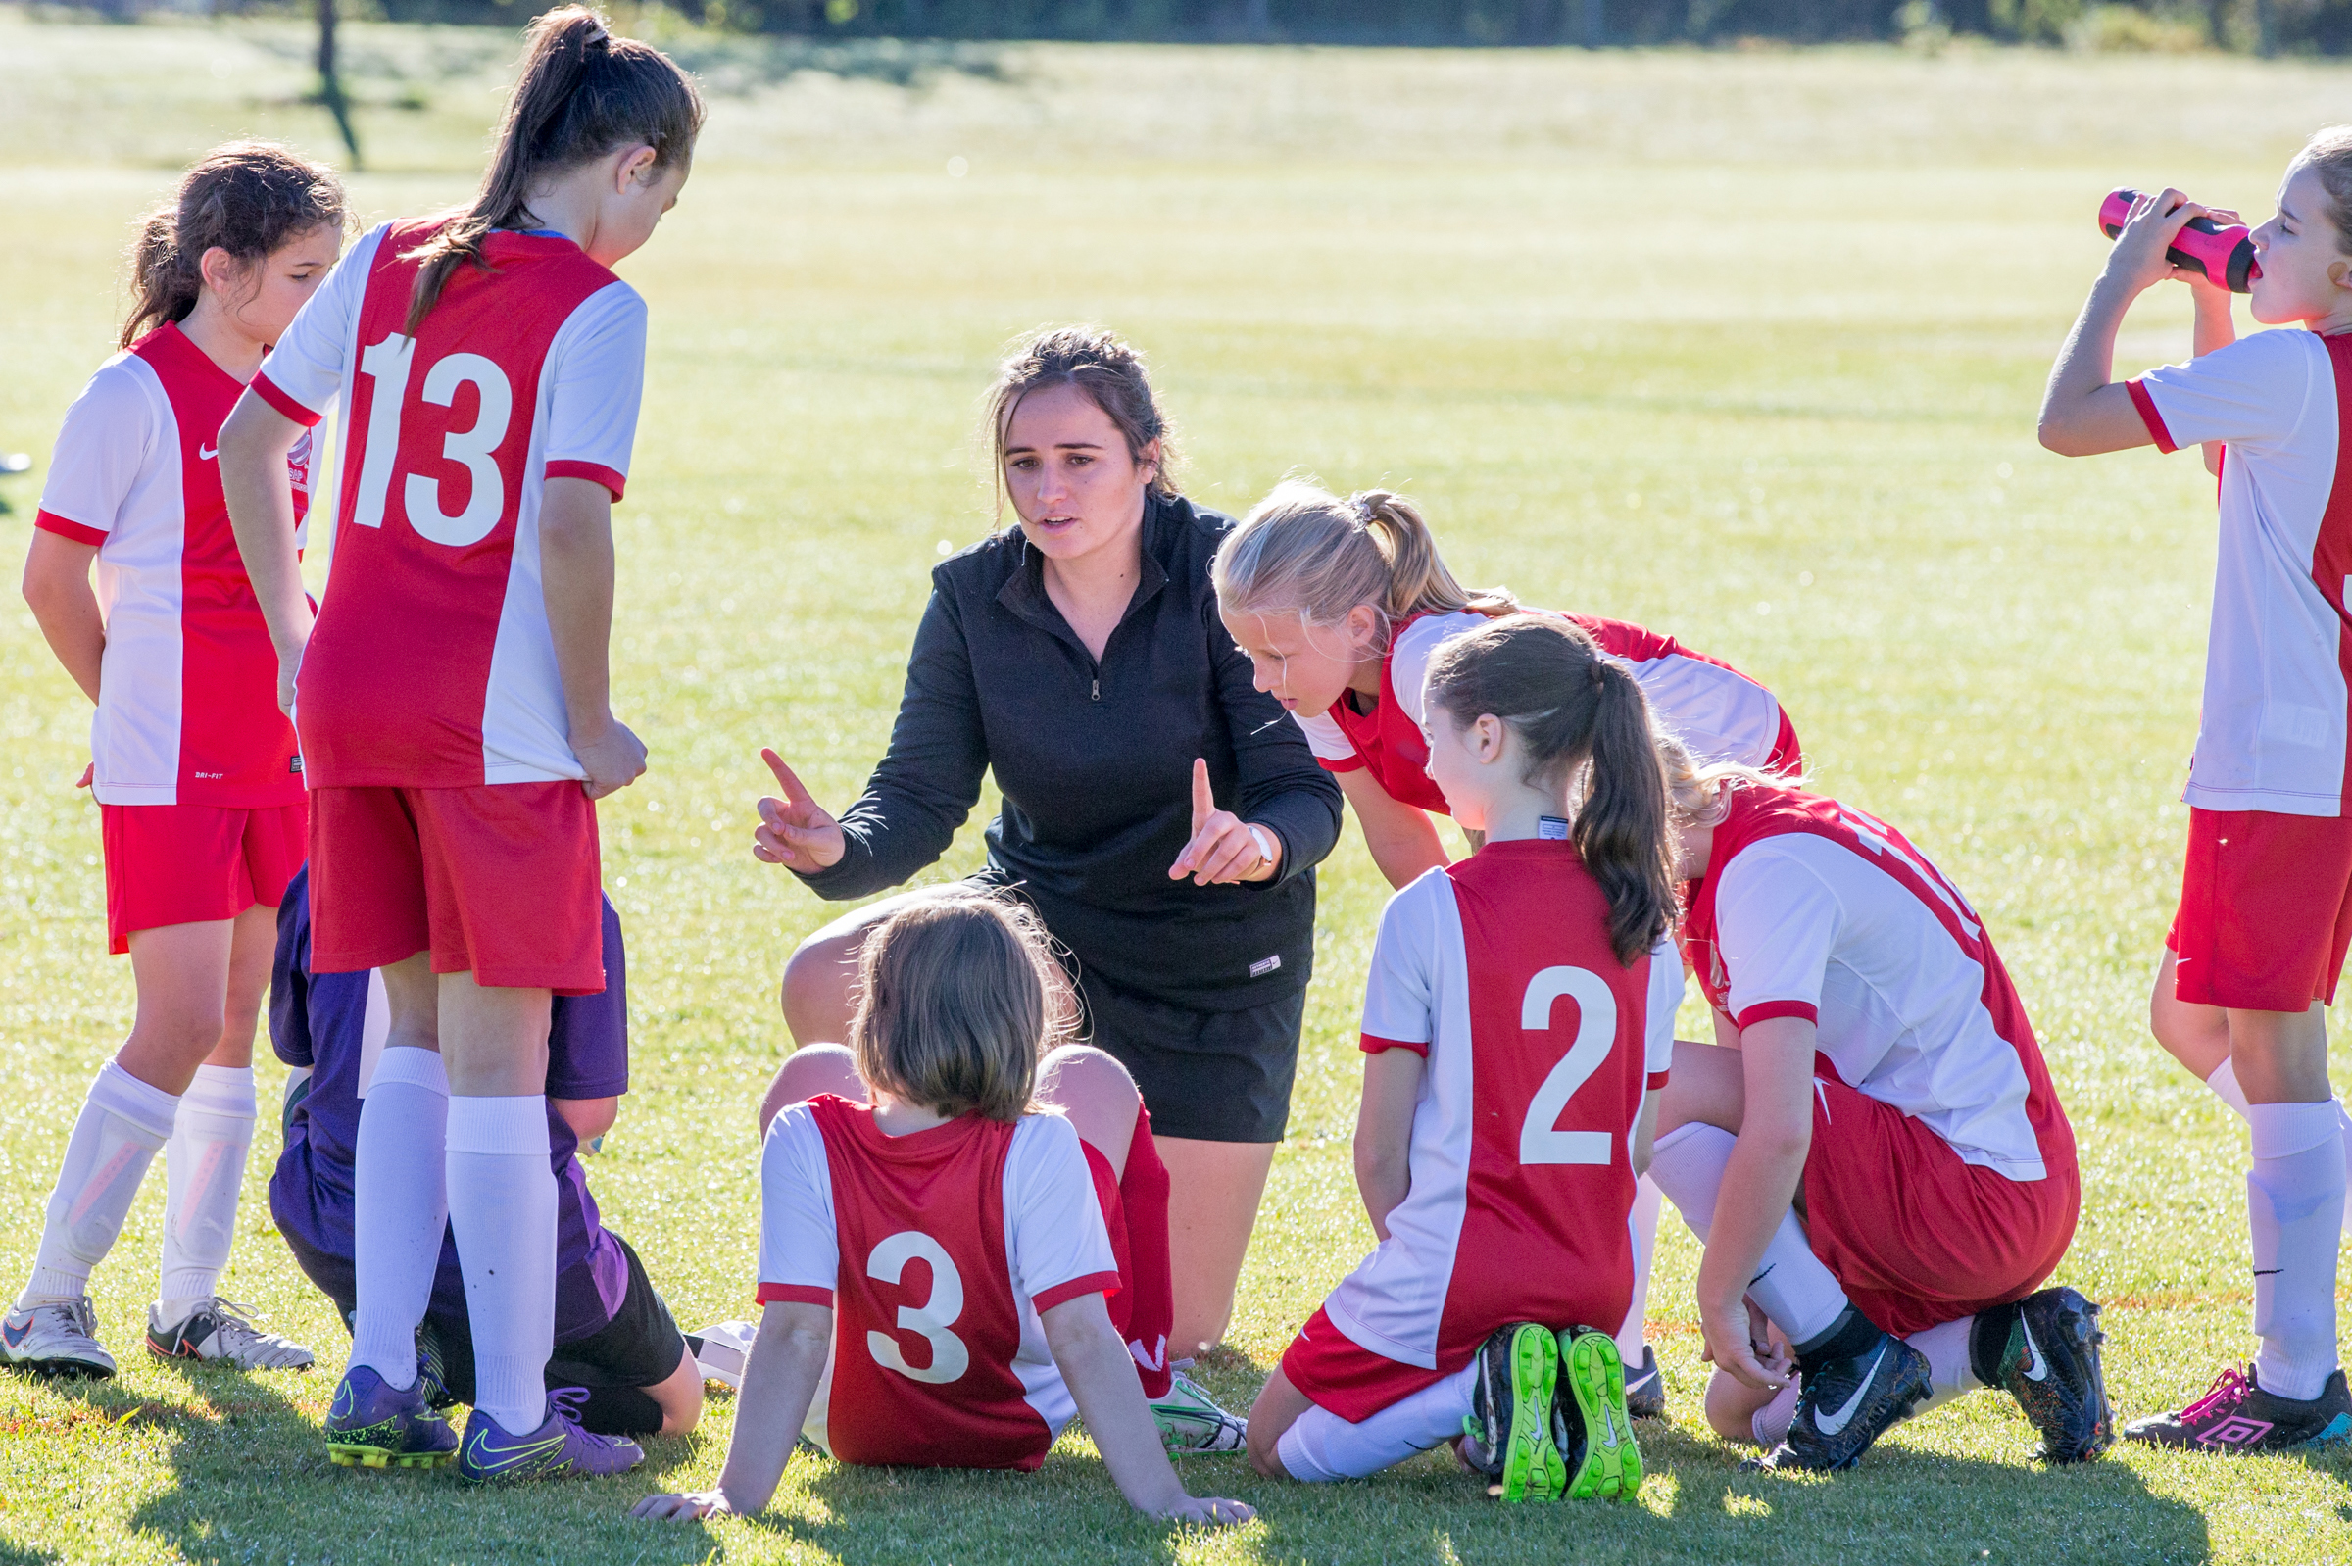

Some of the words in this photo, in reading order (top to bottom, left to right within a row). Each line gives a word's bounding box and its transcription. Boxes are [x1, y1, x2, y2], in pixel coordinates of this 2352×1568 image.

[354, 332, 512, 546] 13
[195, 771, 223, 780] DRI-FIT
[1520, 966, 1616, 1164] 2
[867, 1232, 968, 1383] 3
